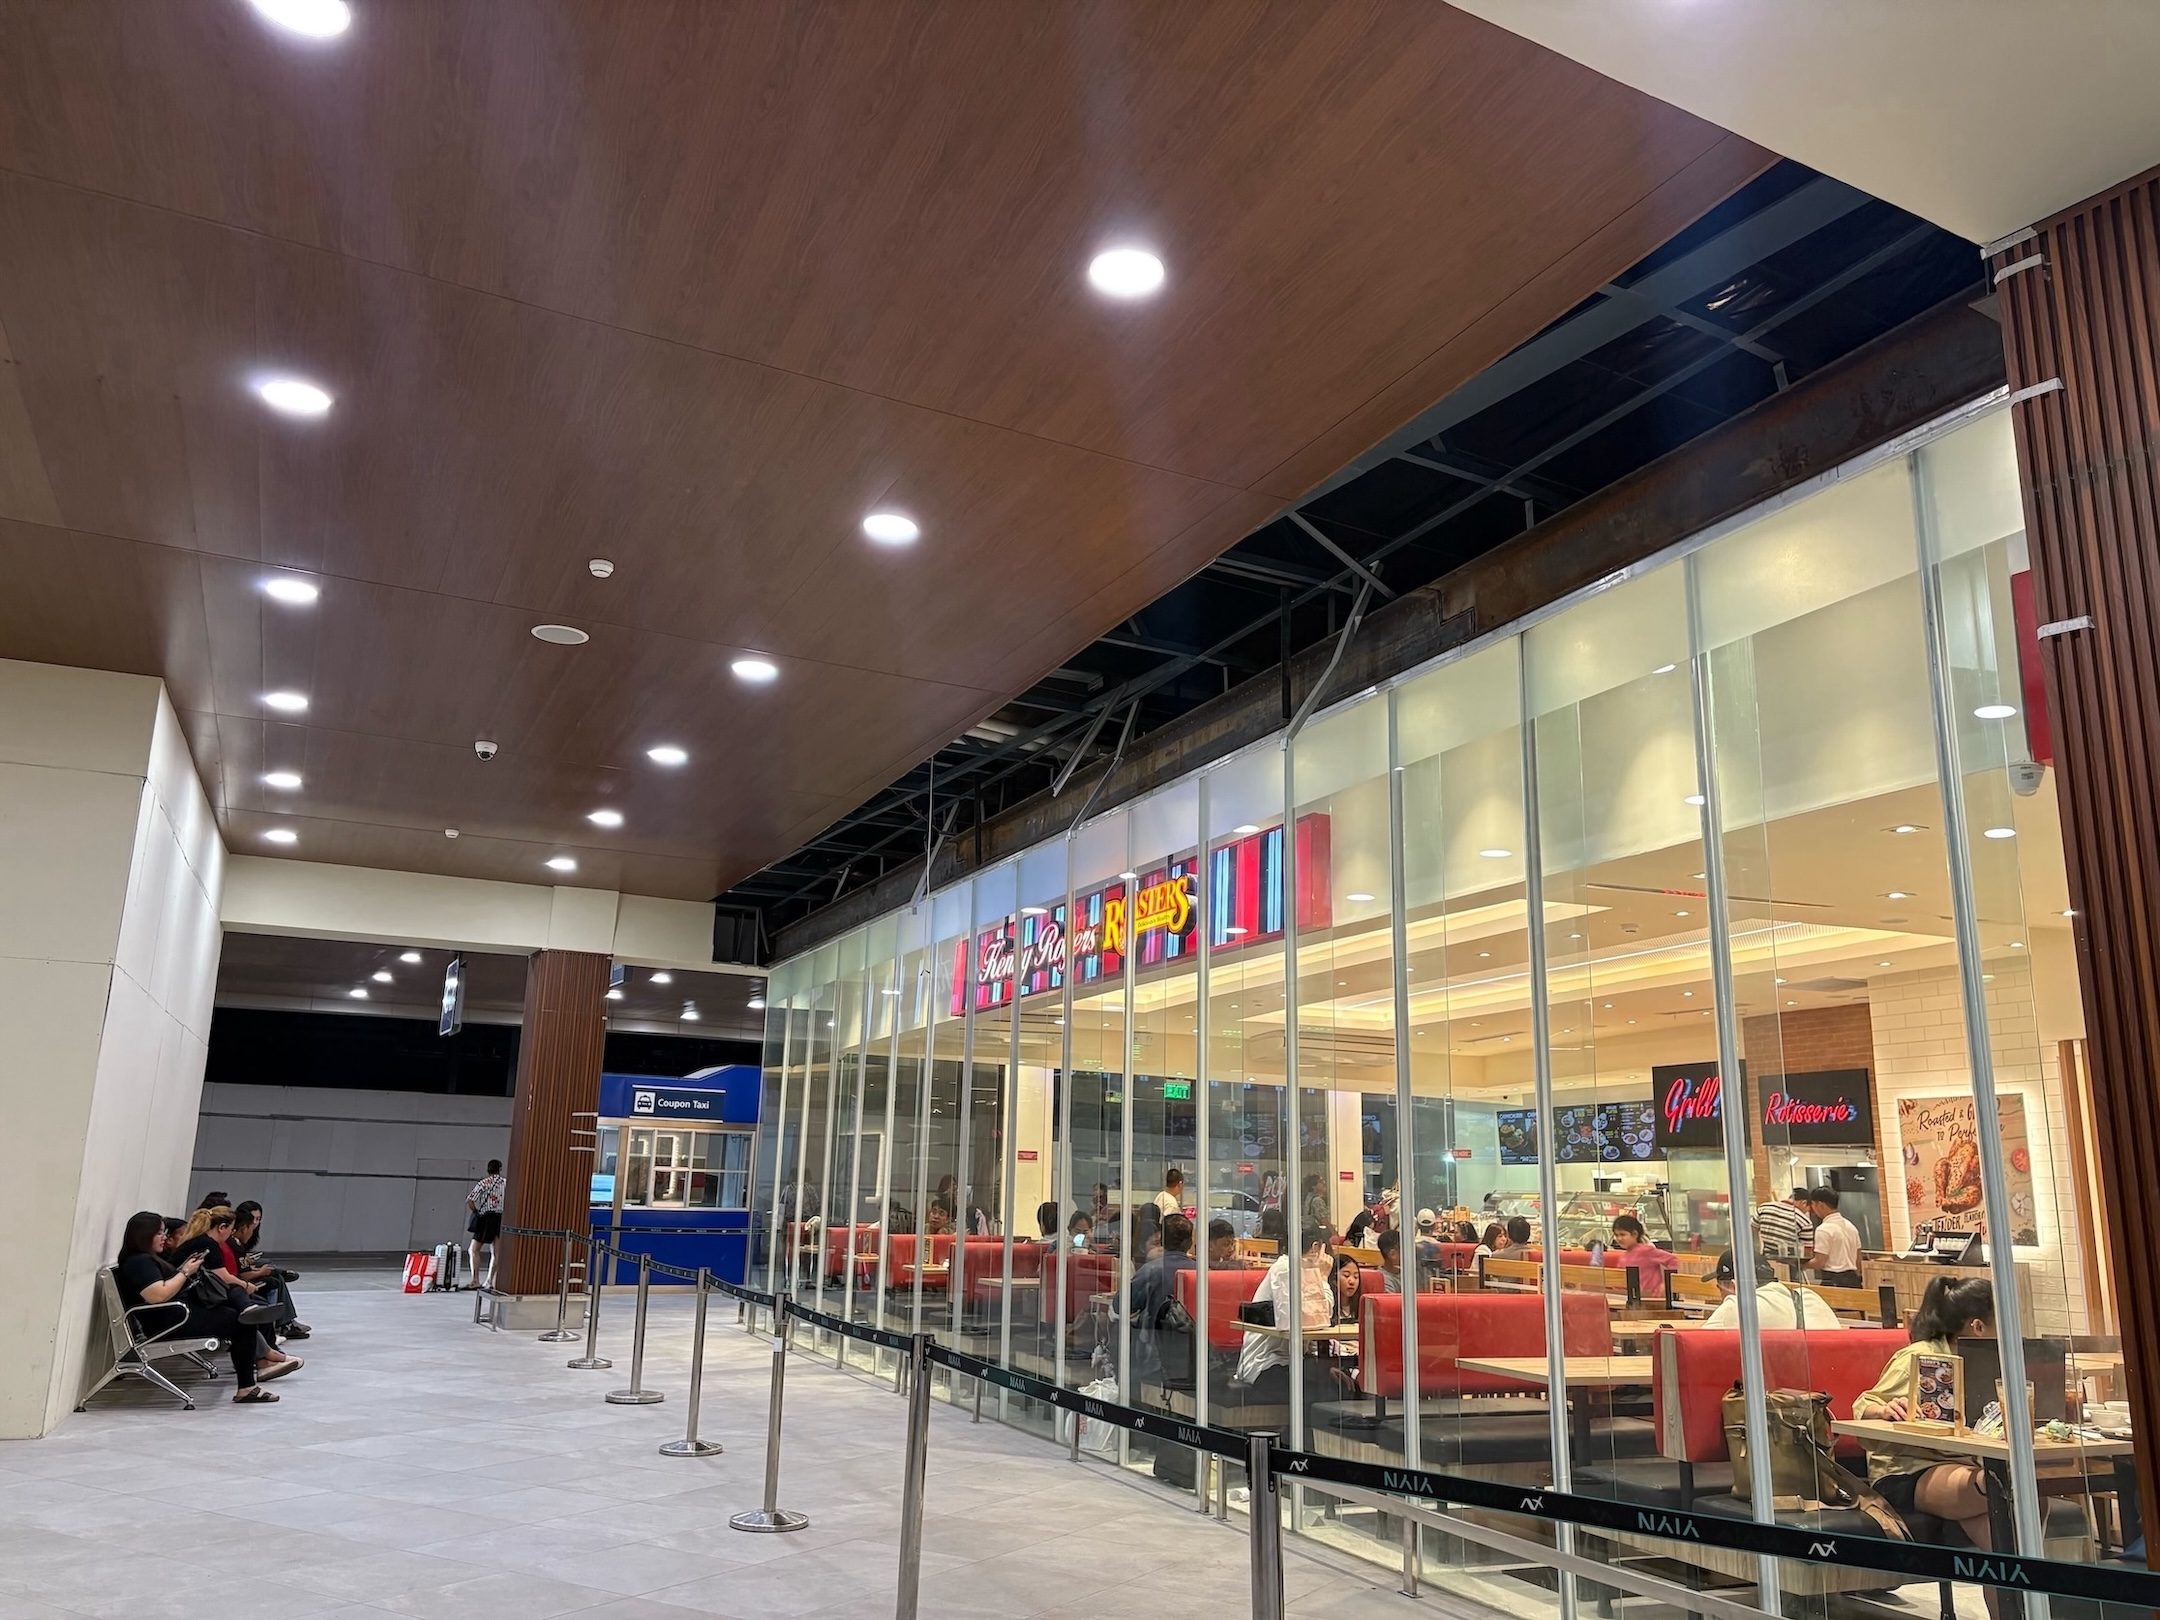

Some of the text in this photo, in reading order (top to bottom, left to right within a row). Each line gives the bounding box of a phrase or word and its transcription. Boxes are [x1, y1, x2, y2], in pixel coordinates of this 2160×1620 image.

[978, 939, 1033, 983] Keny
[657, 1098, 710, 1110] Coupon Taxi
[1765, 1091, 1849, 1125] Rotisserie
[1917, 1107, 1956, 1131] Roasted
[1383, 1471, 1434, 1494] NAIA
[1637, 1511, 1700, 1538] NAIA
[1954, 1555, 2032, 1585] NAIA
